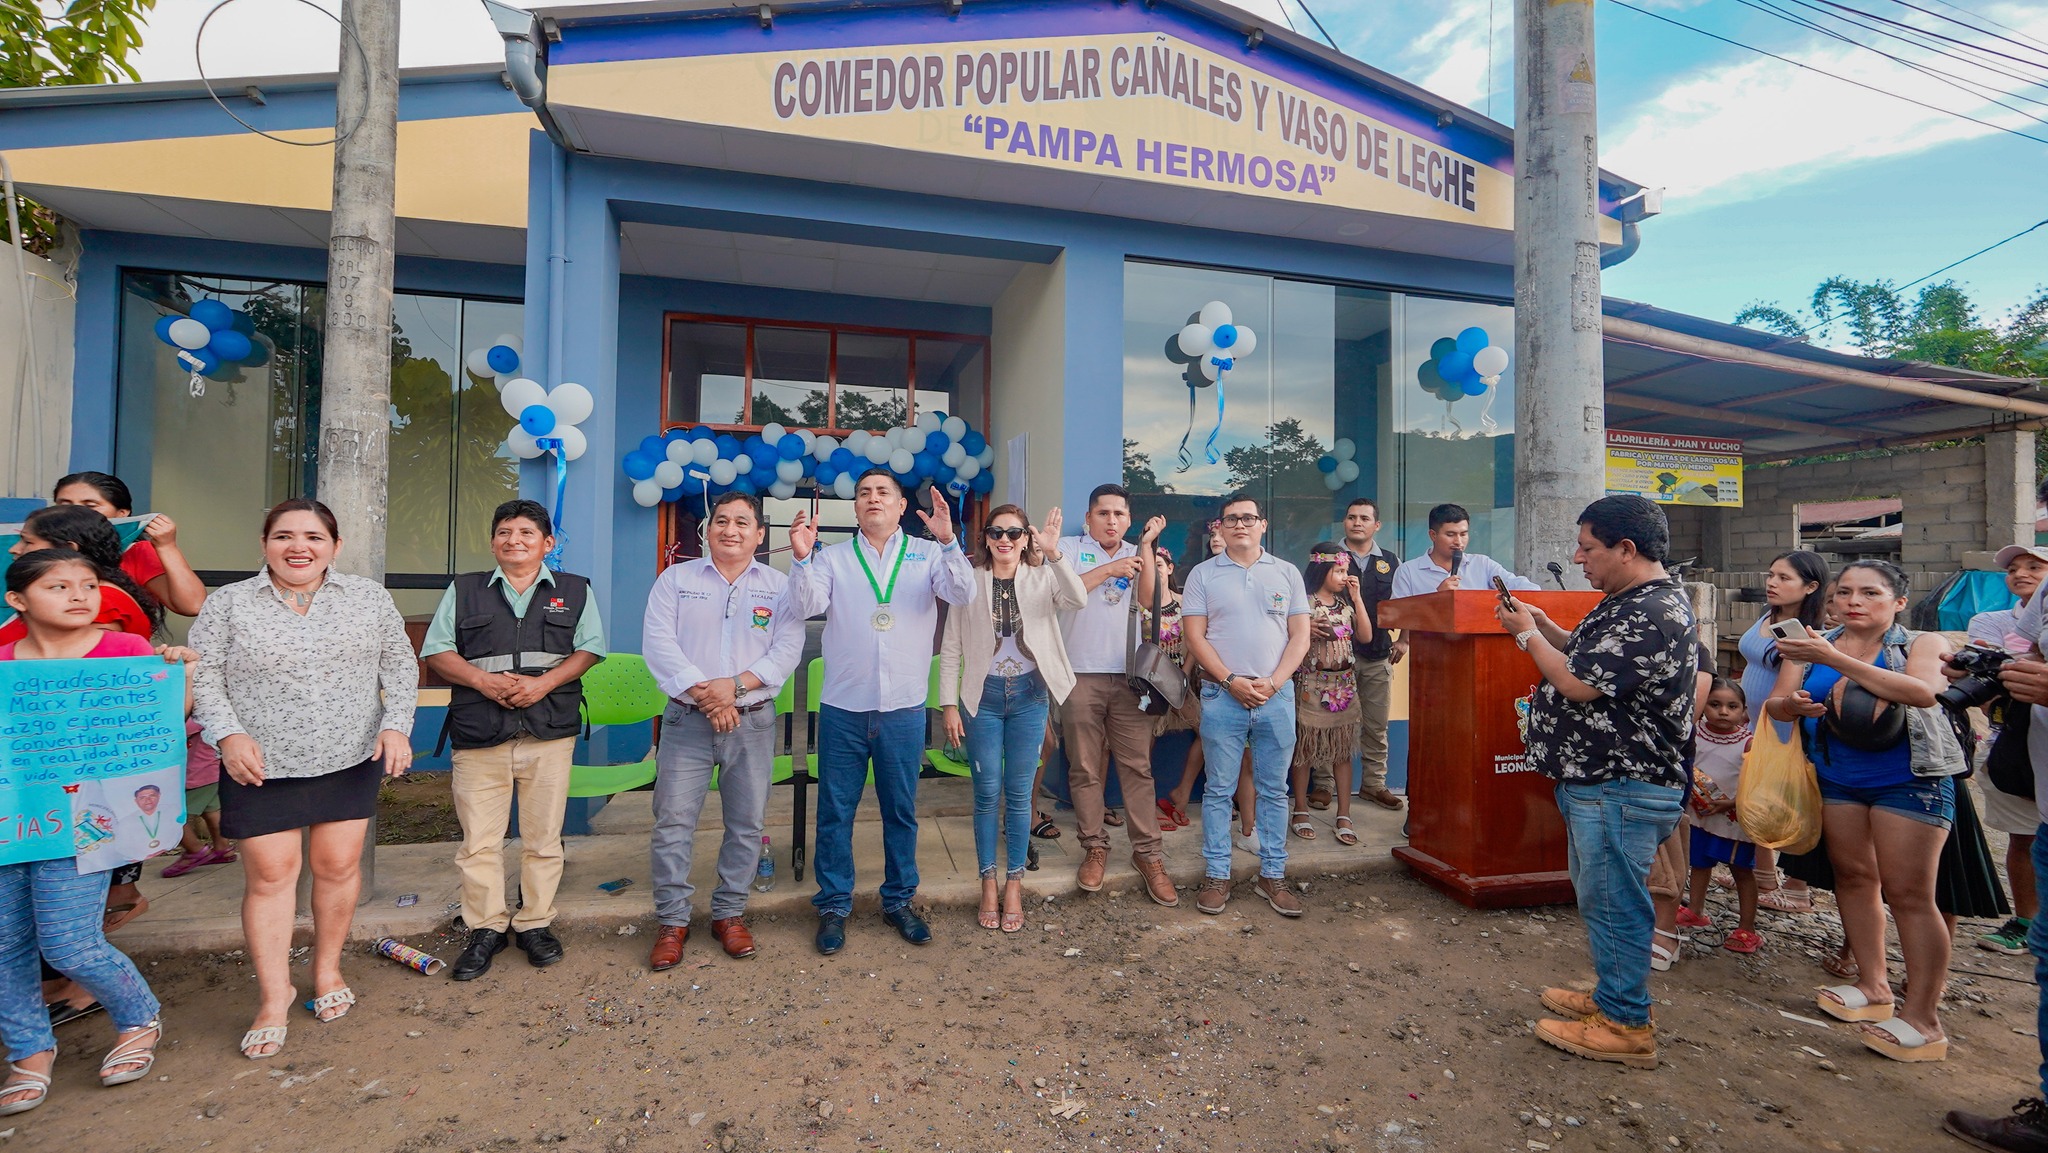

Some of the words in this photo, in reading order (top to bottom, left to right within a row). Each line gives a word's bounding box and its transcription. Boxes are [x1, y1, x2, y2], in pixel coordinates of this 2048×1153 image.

[774, 55, 945, 119] COMEDOR
[956, 47, 1101, 106] POPULAR
[1110, 35, 1242, 123] CAÑALES
[1251, 80, 1269, 132] Y
[1277, 90, 1347, 161] VASO
[1356, 121, 1389, 179] DE
[1397, 137, 1476, 212] LECHE
[1609, 433, 1670, 448] LADRILLERÍA
[1672, 440, 1699, 449] JHAN
[1700, 441, 1707, 449] Y
[1709, 442, 1740, 451] LUCHO
[1610, 449, 1643, 459] FABRICA
[1644, 452, 1650, 460] Y
[1650, 453, 1679, 462] VENTAS
[1690, 455, 1728, 465] LADRILLOS
[1729, 457, 1739, 465] AL
[1636, 460, 1654, 468] POR
[1653, 461, 1681, 470] MAYOR
[1688, 463, 1714, 471] MENOR
[9, 697, 67, 714] Marx
[79, 690, 158, 709] Fuentes
[0, 719, 57, 736] azgo
[116, 725, 172, 741] nuestra
[12, 756, 31, 766] en
[25, 770, 59, 782] vida
[75, 763, 97, 776] de
